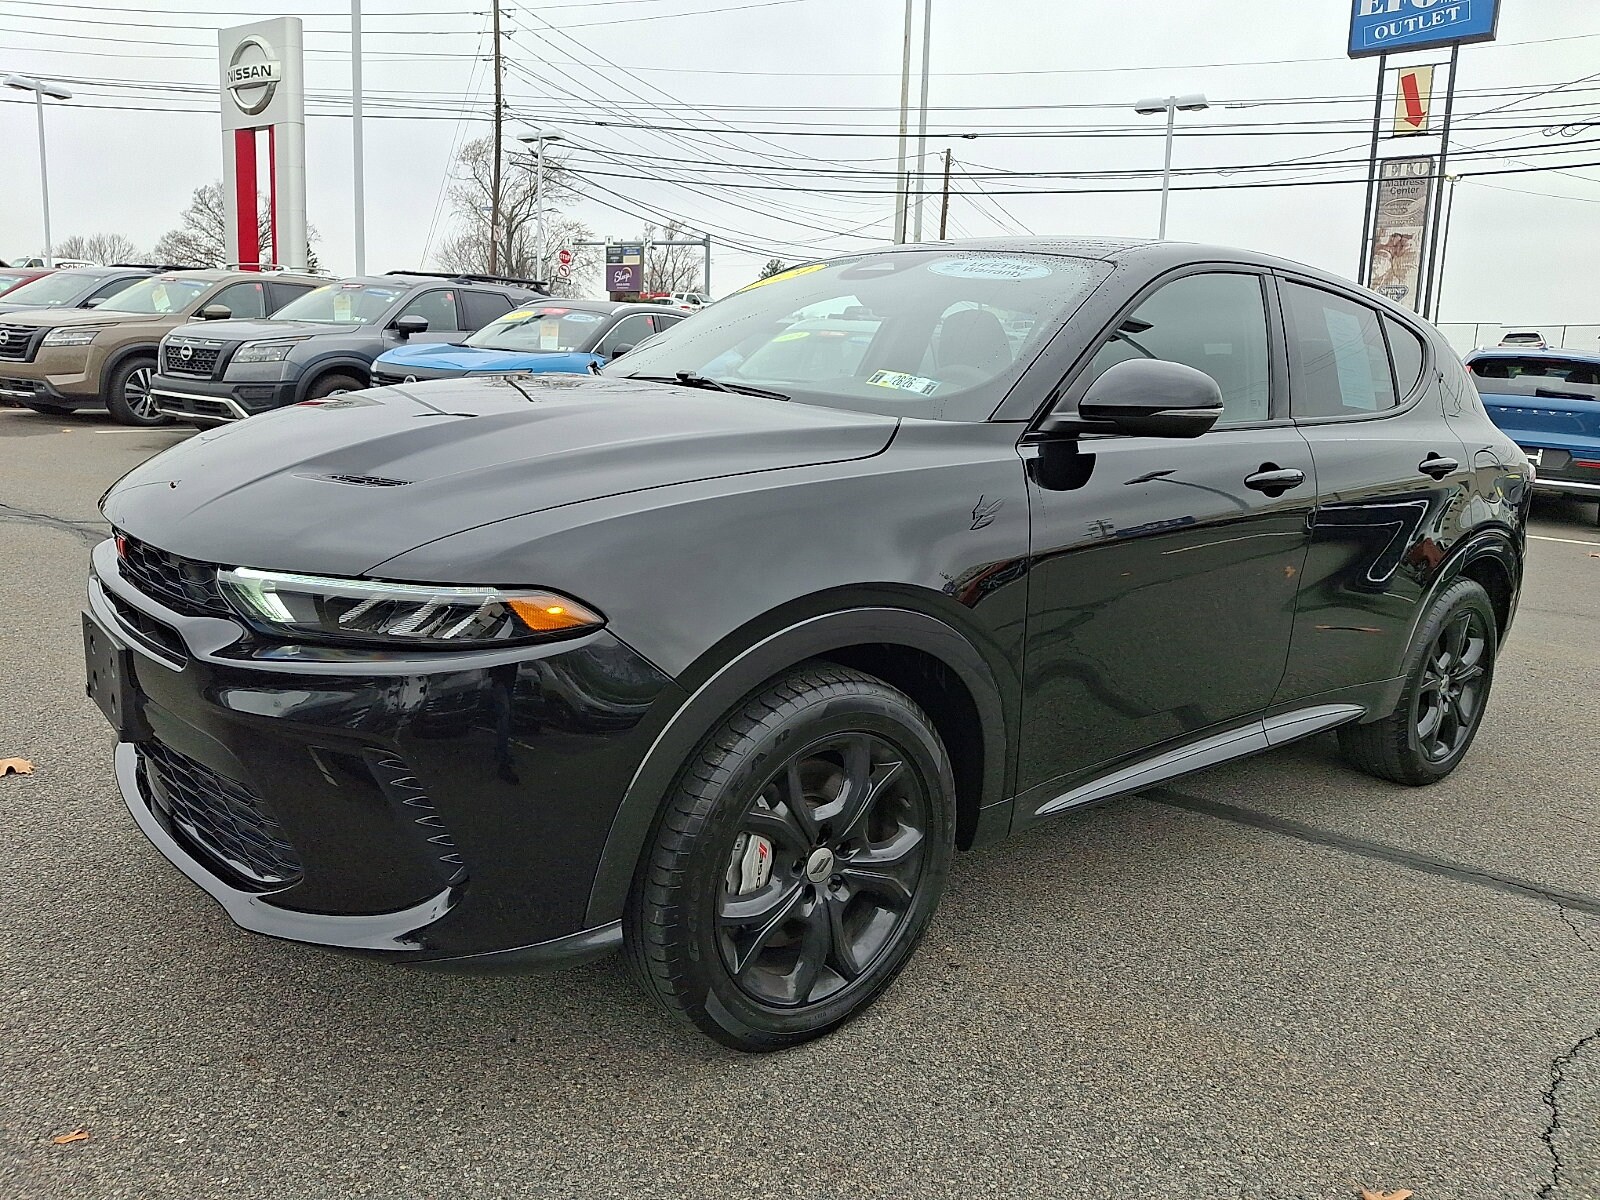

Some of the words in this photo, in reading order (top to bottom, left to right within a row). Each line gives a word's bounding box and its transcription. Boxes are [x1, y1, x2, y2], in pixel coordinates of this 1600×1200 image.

[1374, 6, 1461, 39] OUTLET
[227, 64, 272, 83] NISSAN
[1384, 162, 1429, 177] EFO
[1385, 179, 1426, 187] Mattress
[1390, 186, 1420, 195] Center
[963, 266, 1025, 277] Warranty
